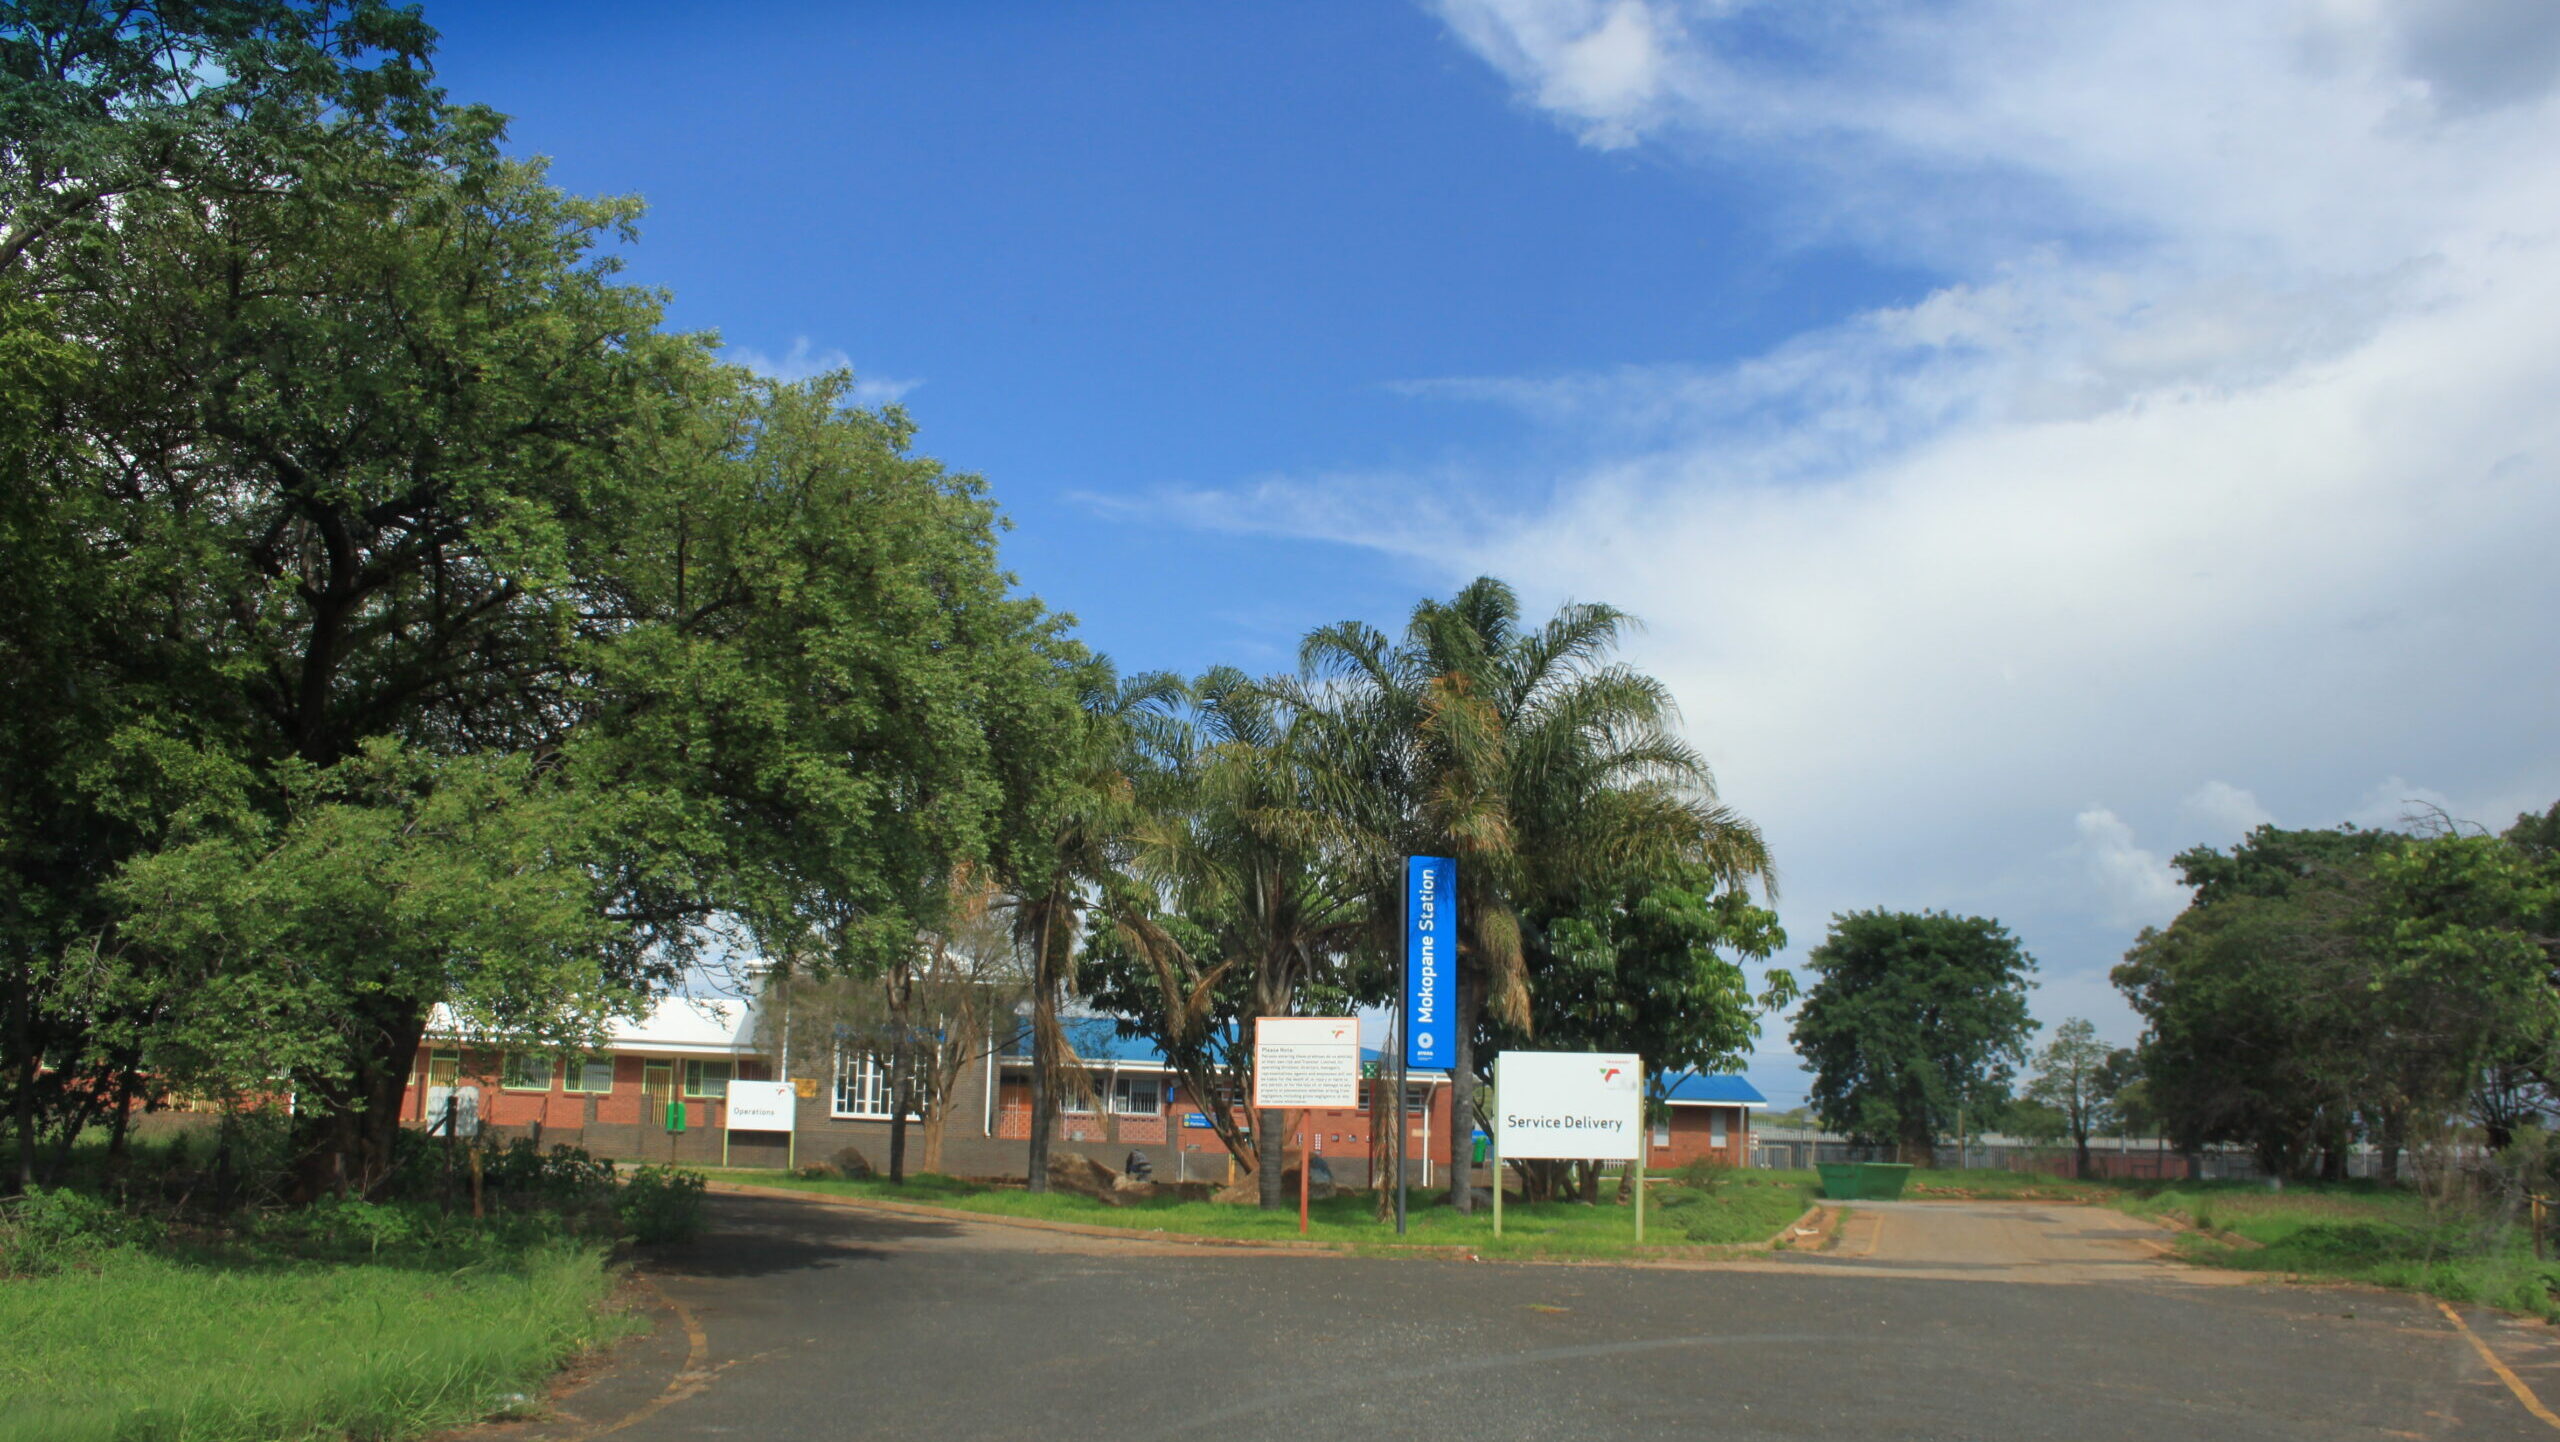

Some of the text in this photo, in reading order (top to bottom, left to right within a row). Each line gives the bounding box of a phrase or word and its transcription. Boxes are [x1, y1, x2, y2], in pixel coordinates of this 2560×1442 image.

[1418, 869, 1437, 1023] Mokopane Station
[734, 1107, 775, 1116] Operations
[1508, 1115, 1623, 1133] Service Delivery
